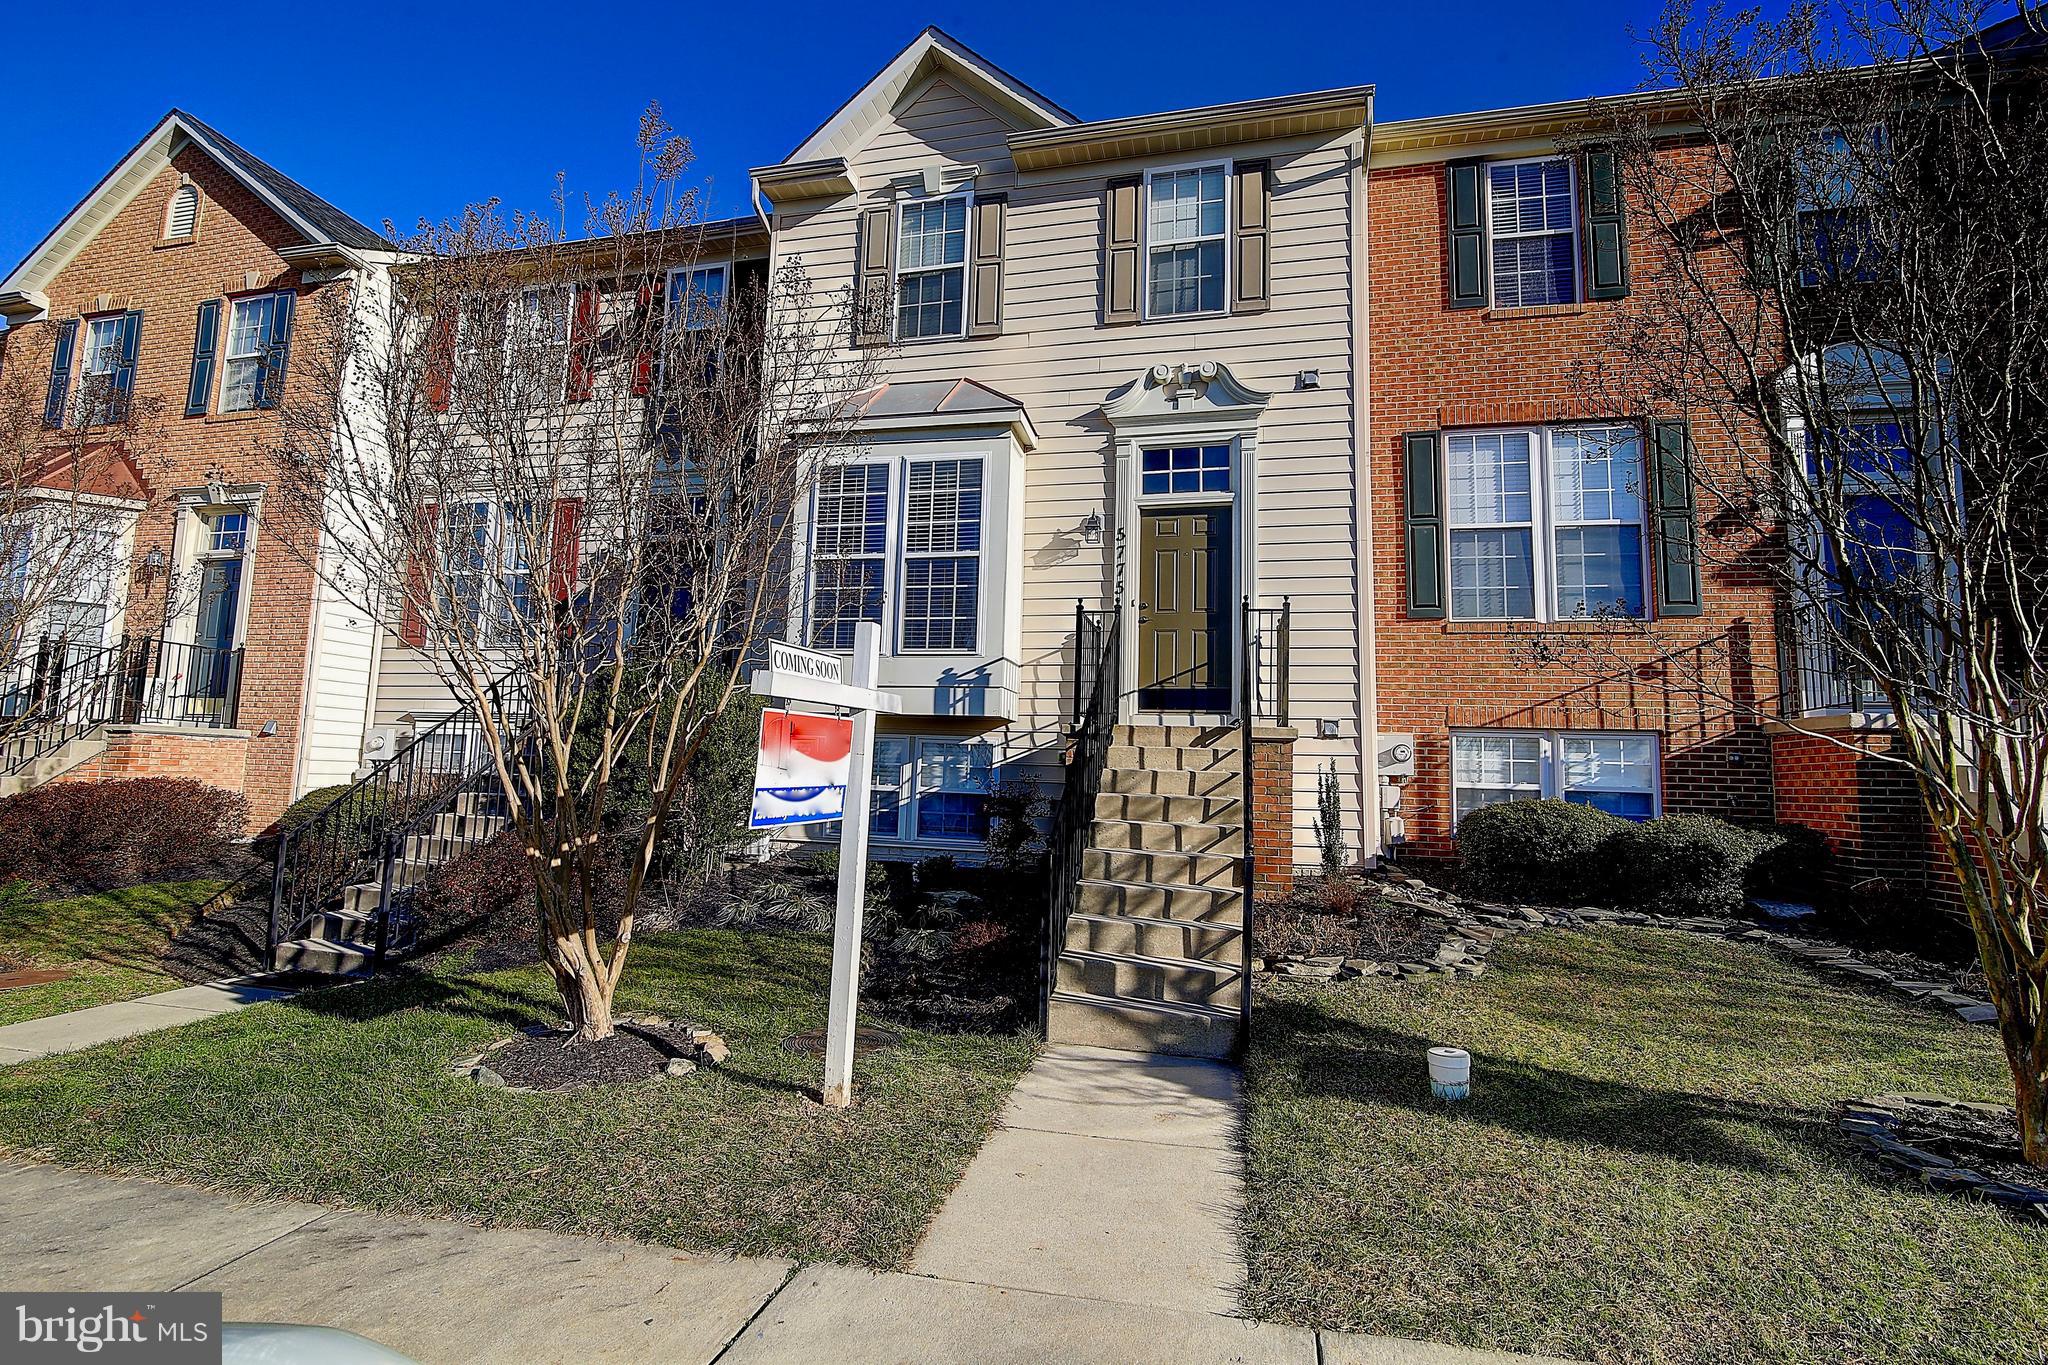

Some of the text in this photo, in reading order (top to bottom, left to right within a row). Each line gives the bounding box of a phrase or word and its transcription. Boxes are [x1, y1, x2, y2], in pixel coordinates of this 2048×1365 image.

[1114, 526, 1126, 595] 5775
[774, 649, 839, 680] COMING SOON
